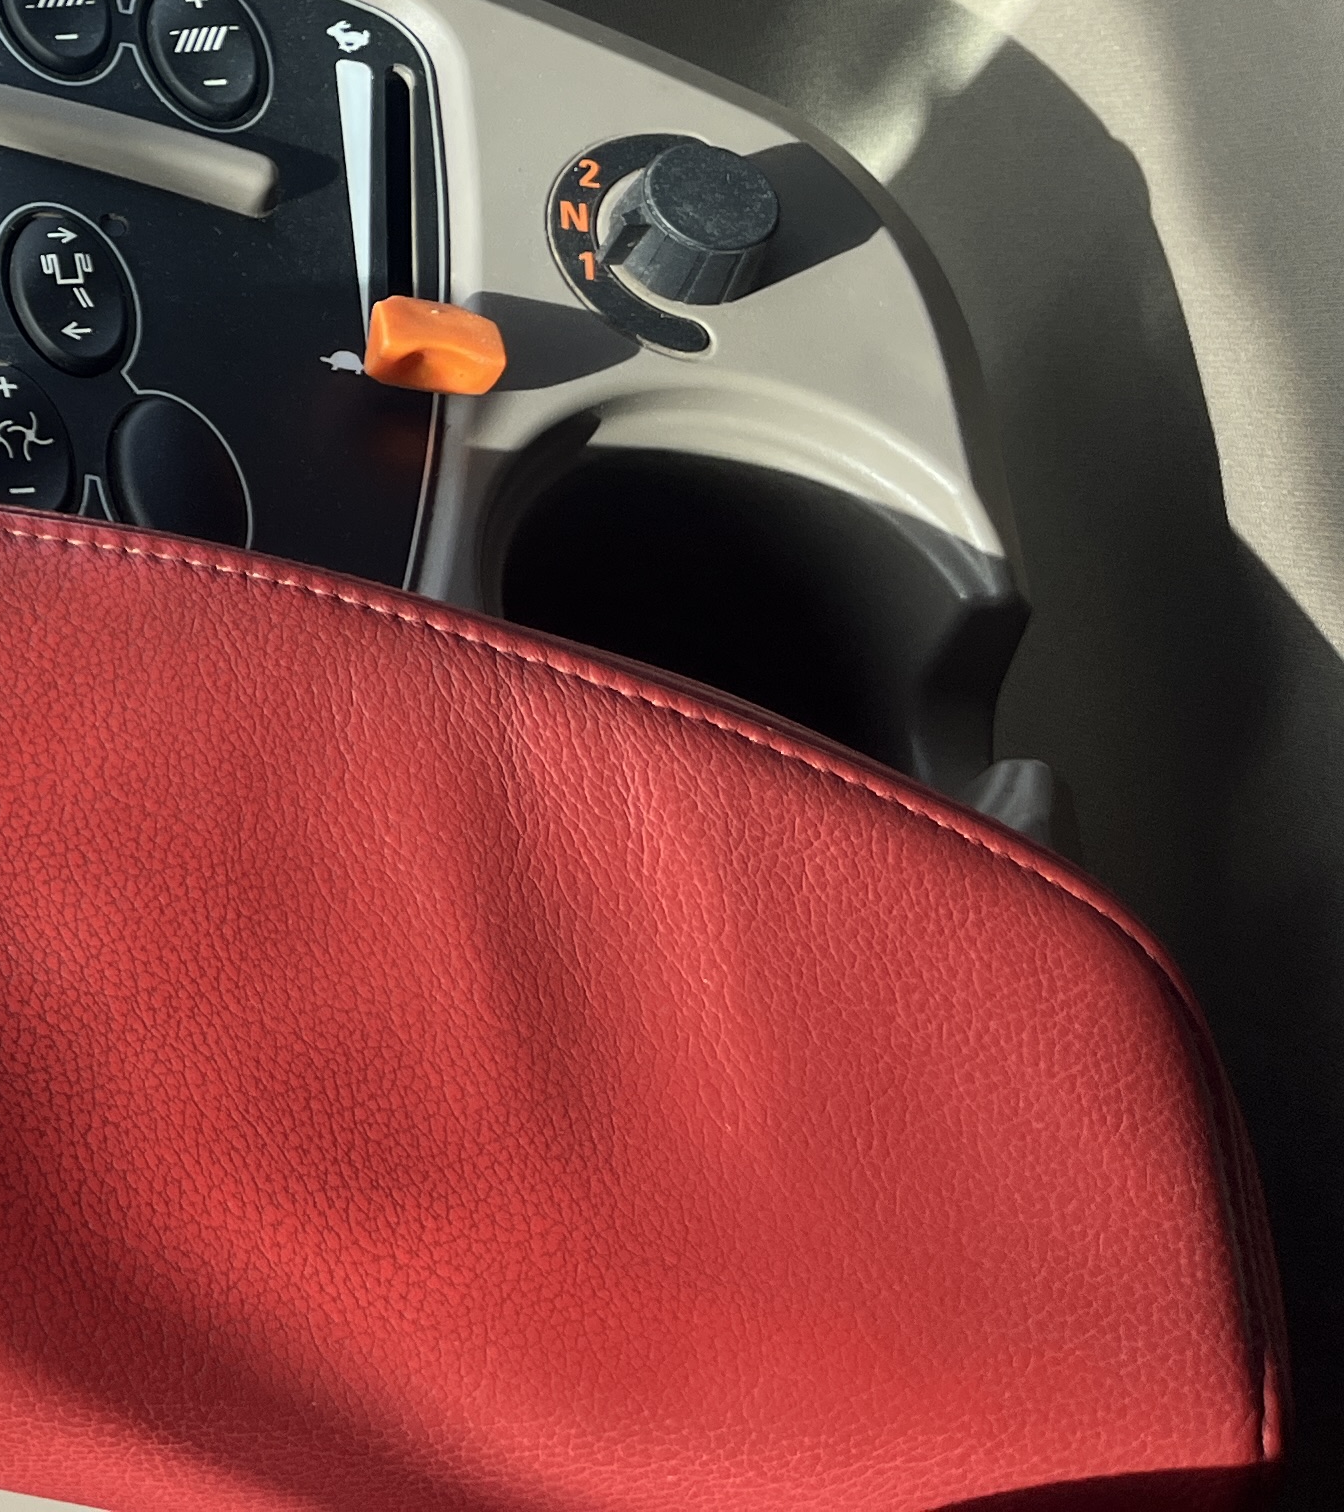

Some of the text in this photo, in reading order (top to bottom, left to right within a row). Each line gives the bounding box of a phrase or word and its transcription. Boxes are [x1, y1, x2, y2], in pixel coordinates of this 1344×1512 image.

[578, 159, 601, 188] 2
[559, 201, 589, 231] N
[577, 252, 595, 281] 1
